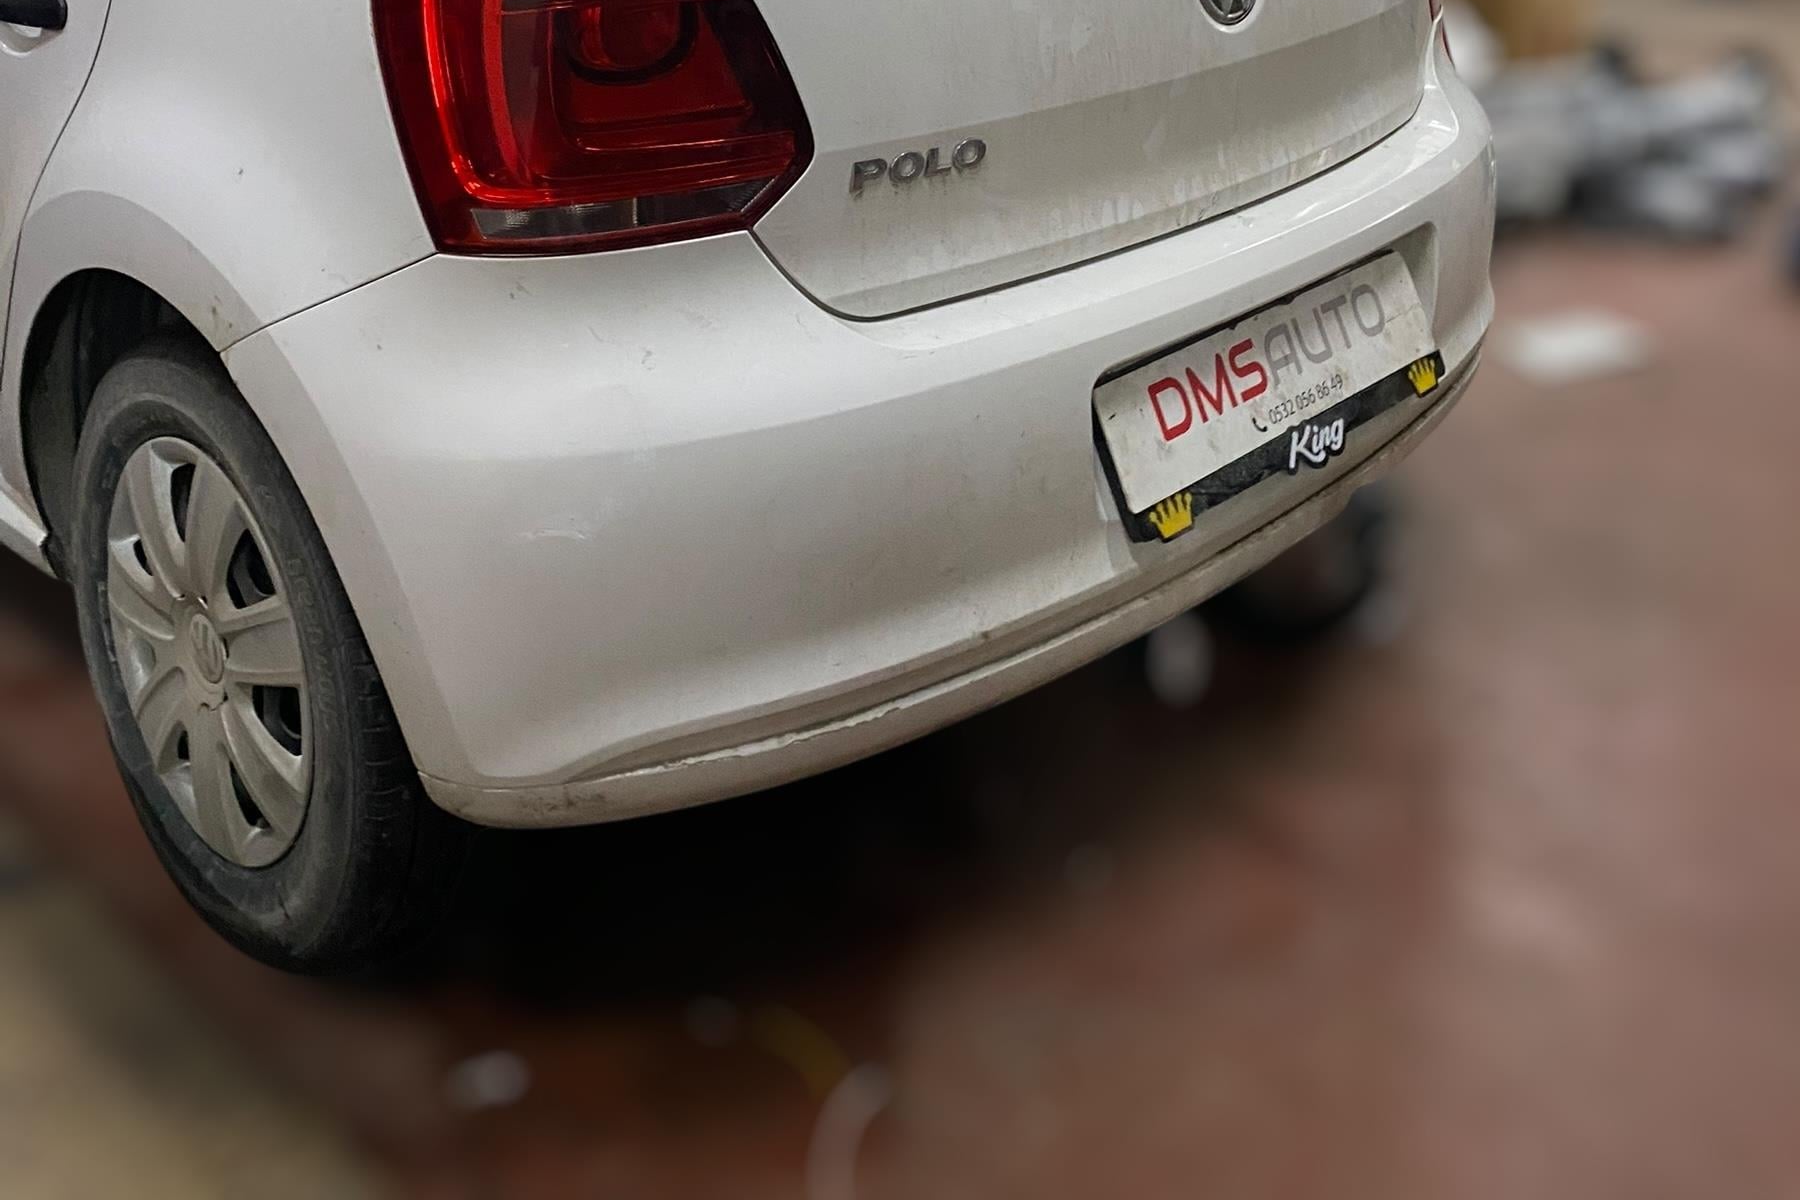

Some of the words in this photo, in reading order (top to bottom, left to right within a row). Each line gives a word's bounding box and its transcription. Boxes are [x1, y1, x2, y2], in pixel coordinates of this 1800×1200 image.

[850, 137, 987, 193] POLO
[1268, 399, 1297, 424] 0532
[1295, 388, 1316, 410] 056
[1315, 380, 1330, 399] 86
[1330, 373, 1344, 390] 49
[1289, 418, 1344, 469] King
